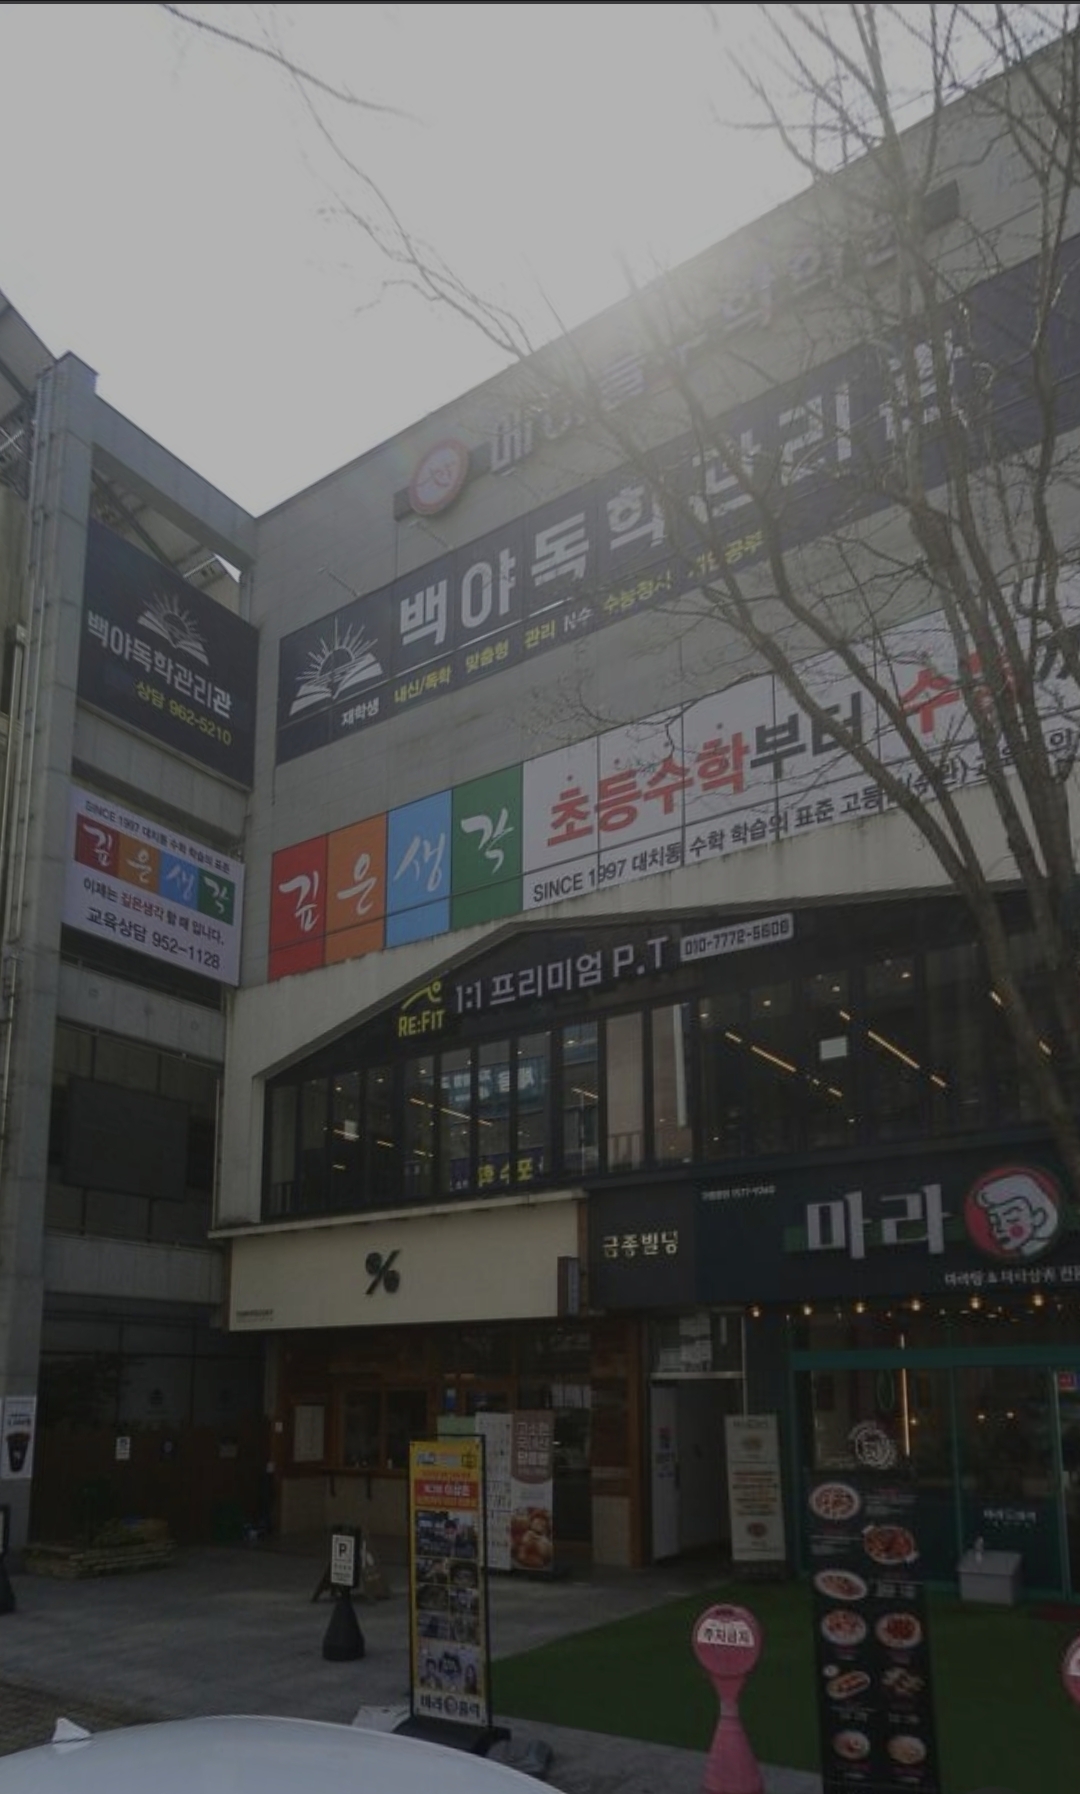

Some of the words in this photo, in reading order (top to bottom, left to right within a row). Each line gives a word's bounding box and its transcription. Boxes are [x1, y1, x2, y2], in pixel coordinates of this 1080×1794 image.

[88, 610, 232, 719] 백야독학관리관
[341, 697, 380, 726] 재학생
[524, 619, 556, 650] 관리
[135, 681, 165, 710] 상담
[169, 699, 233, 747] 962-5210
[547, 691, 862, 848] 초등수학부터
[118, 815, 140, 832] 1997
[533, 872, 583, 902] SINCE
[589, 859, 627, 887] 1997
[631, 841, 683, 871] 대치동
[690, 829, 726, 858] 수학
[731, 812, 790, 845] 학습의
[795, 797, 835, 829] 표준
[83, 876, 118, 903] 이제는
[121, 891, 164, 922] 깊은생각
[192, 919, 225, 946] 입니다.
[87, 907, 147, 943] 교육상담
[152, 931, 221, 970] 952-1128
[454, 982, 482, 1013] 1:1
[490, 952, 603, 1005] 프리미엄
[612, 936, 669, 978] P.T
[398, 1010, 445, 1037] RE:FIT
[806, 1184, 953, 1260] 마라
